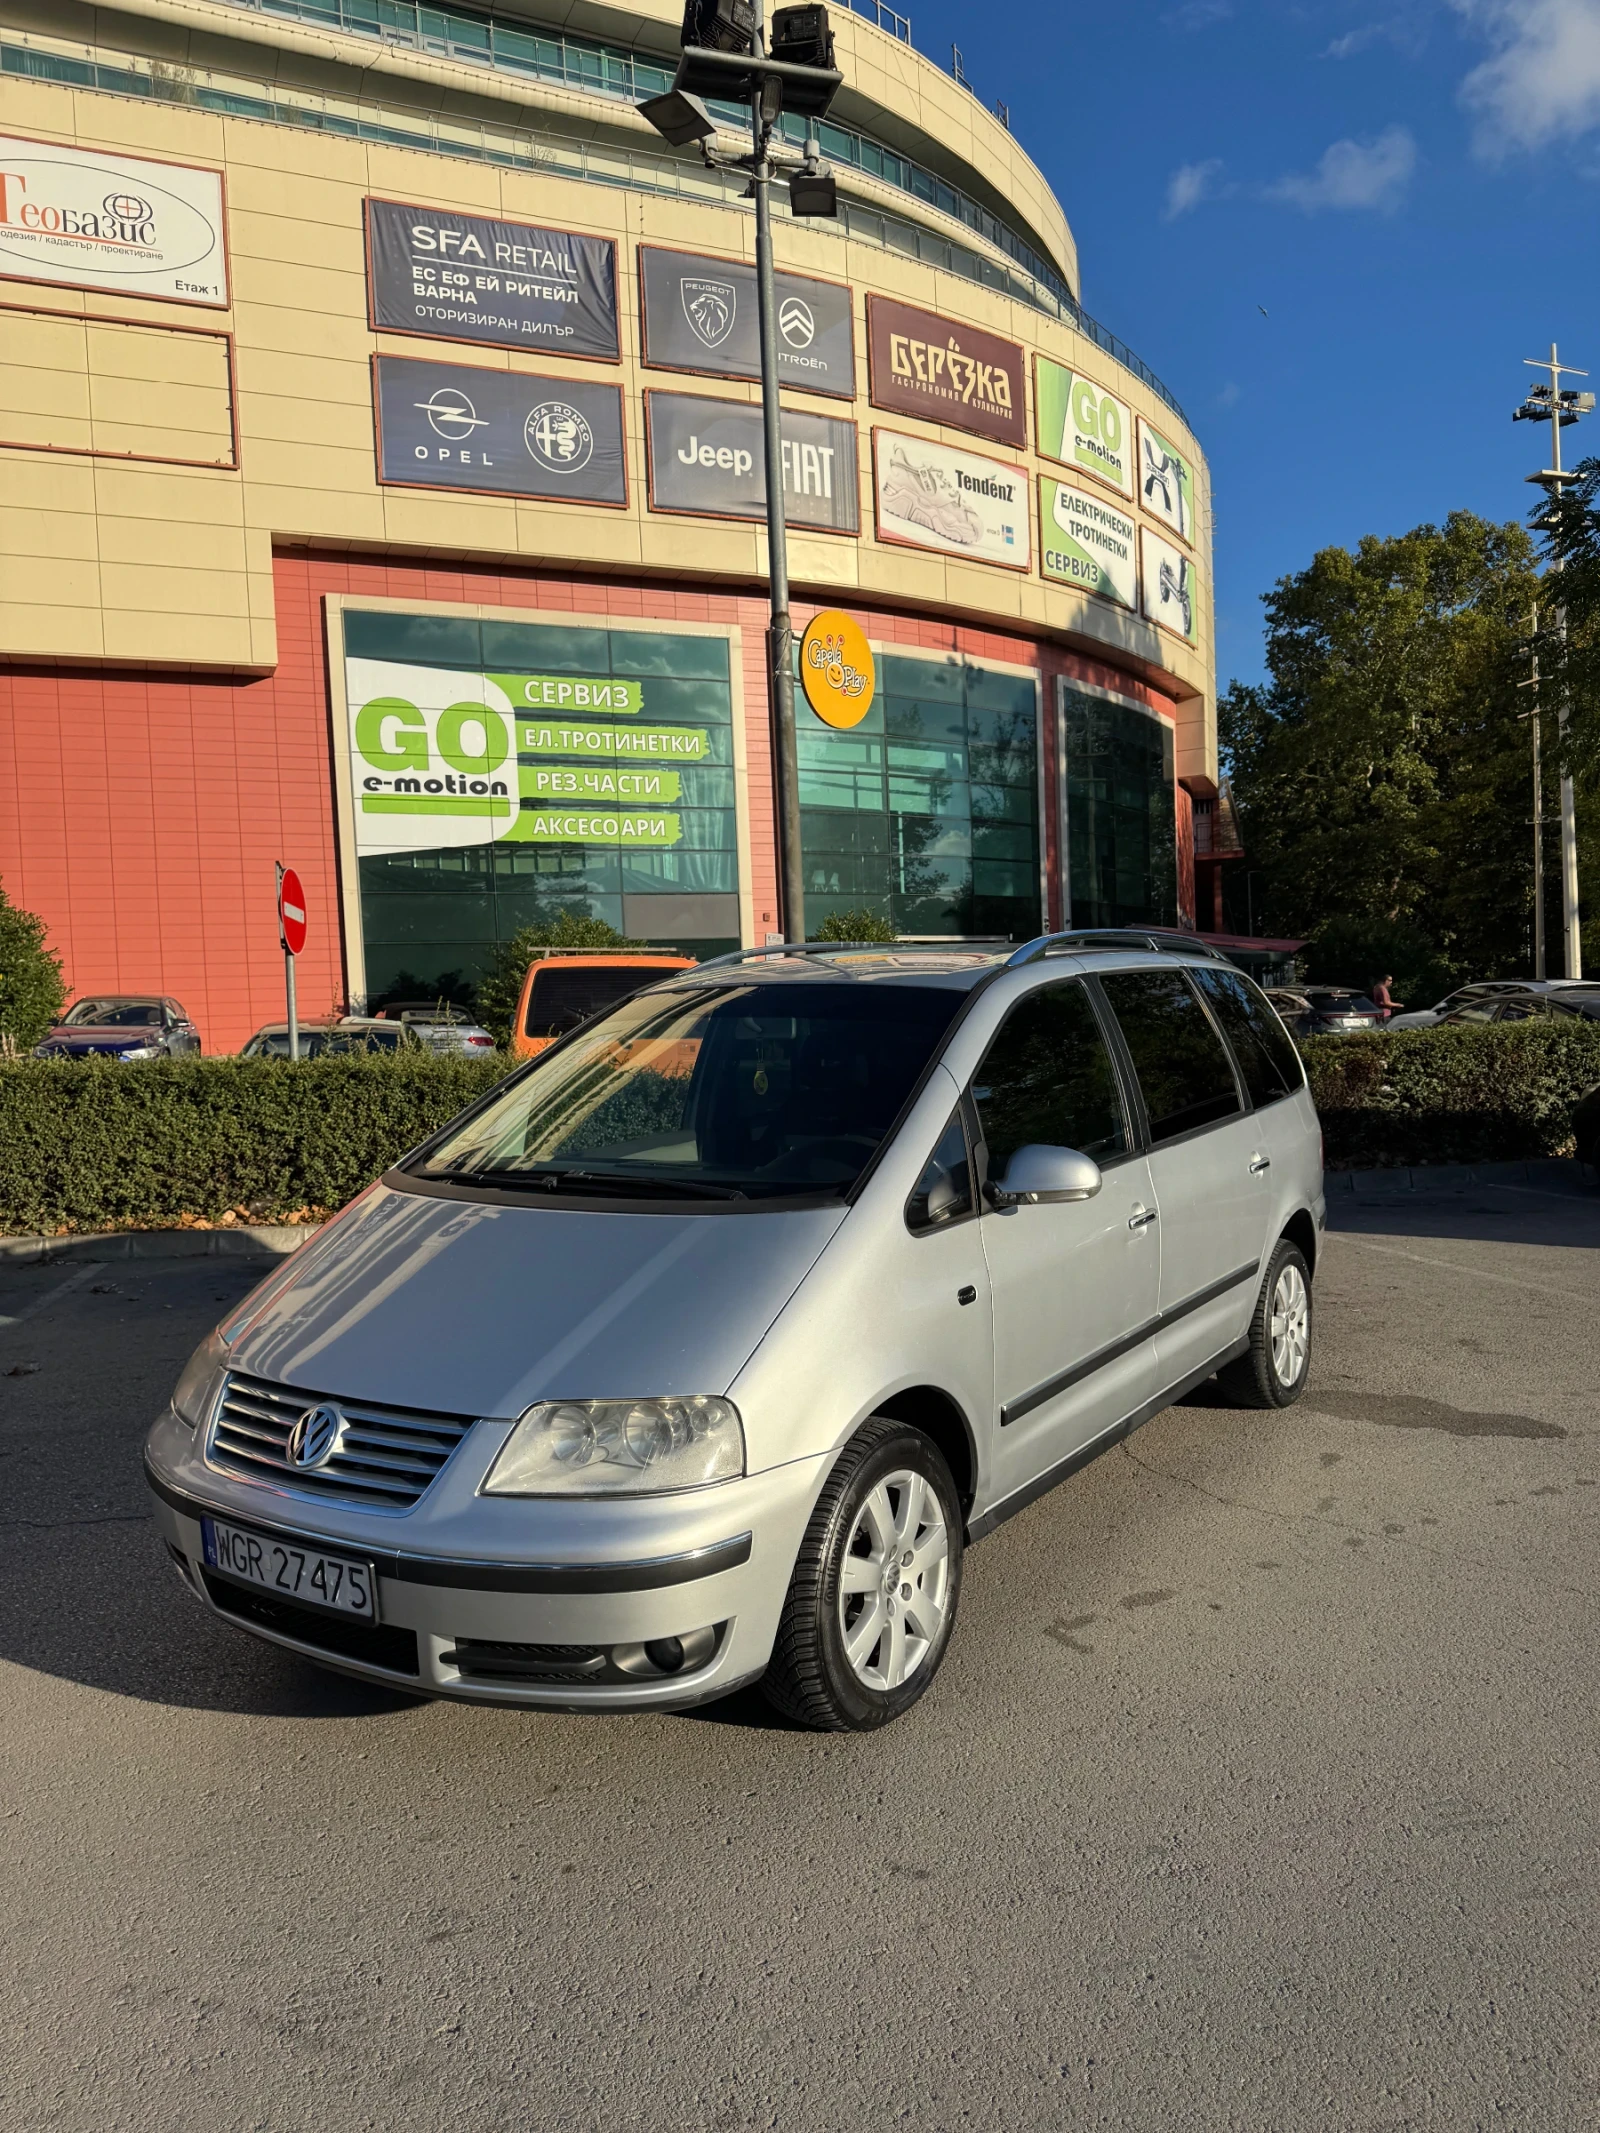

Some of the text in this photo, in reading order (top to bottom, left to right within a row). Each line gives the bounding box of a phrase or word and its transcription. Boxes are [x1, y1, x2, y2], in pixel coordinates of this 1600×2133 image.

[0, 230, 37, 242] одезия
[45, 236, 92, 251] кадастър
[101, 244, 163, 260] проектиране
[411, 225, 577, 274] SFA RETAIL
[175, 280, 218, 296] Етаж 1
[412, 266, 579, 304] ЕС ЕФ ЕЙ РИТЕЙЛ
[413, 283, 477, 305] ВАРНА
[685, 282, 731, 296] PEUGEOT
[415, 305, 574, 337] ОТОРИЗИРАН ДИЛЪР
[778, 352, 828, 371] ITROËN
[891, 375, 959, 401] ГАСТРОНОМИЯ
[527, 405, 590, 443] ALFA ROMEO
[1071, 381, 1122, 452] GO
[414, 446, 493, 466] OPEL
[677, 436, 753, 477] Jeep
[1075, 435, 1122, 470] e-motion
[781, 440, 834, 498] FIAT
[1060, 492, 1133, 541] ЕЛЕКТРИЧЕСКИ
[1069, 520, 1128, 561] ТРОТИНЕТКИ
[1045, 550, 1098, 583] СЕРВИЗ
[808, 635, 842, 669] Capella
[524, 680, 629, 708] СЕРВИЗ
[843, 666, 868, 697] Play
[355, 697, 509, 775] GO
[524, 728, 700, 753] ЕЛ.ТРОТИНЕТКИ
[363, 774, 508, 796] e-motion
[536, 772, 661, 794] РЕЗ.ЧАСТИ
[533, 817, 666, 837] АКСЕСОАРИ
[216, 1525, 367, 1610] WGR 27475
